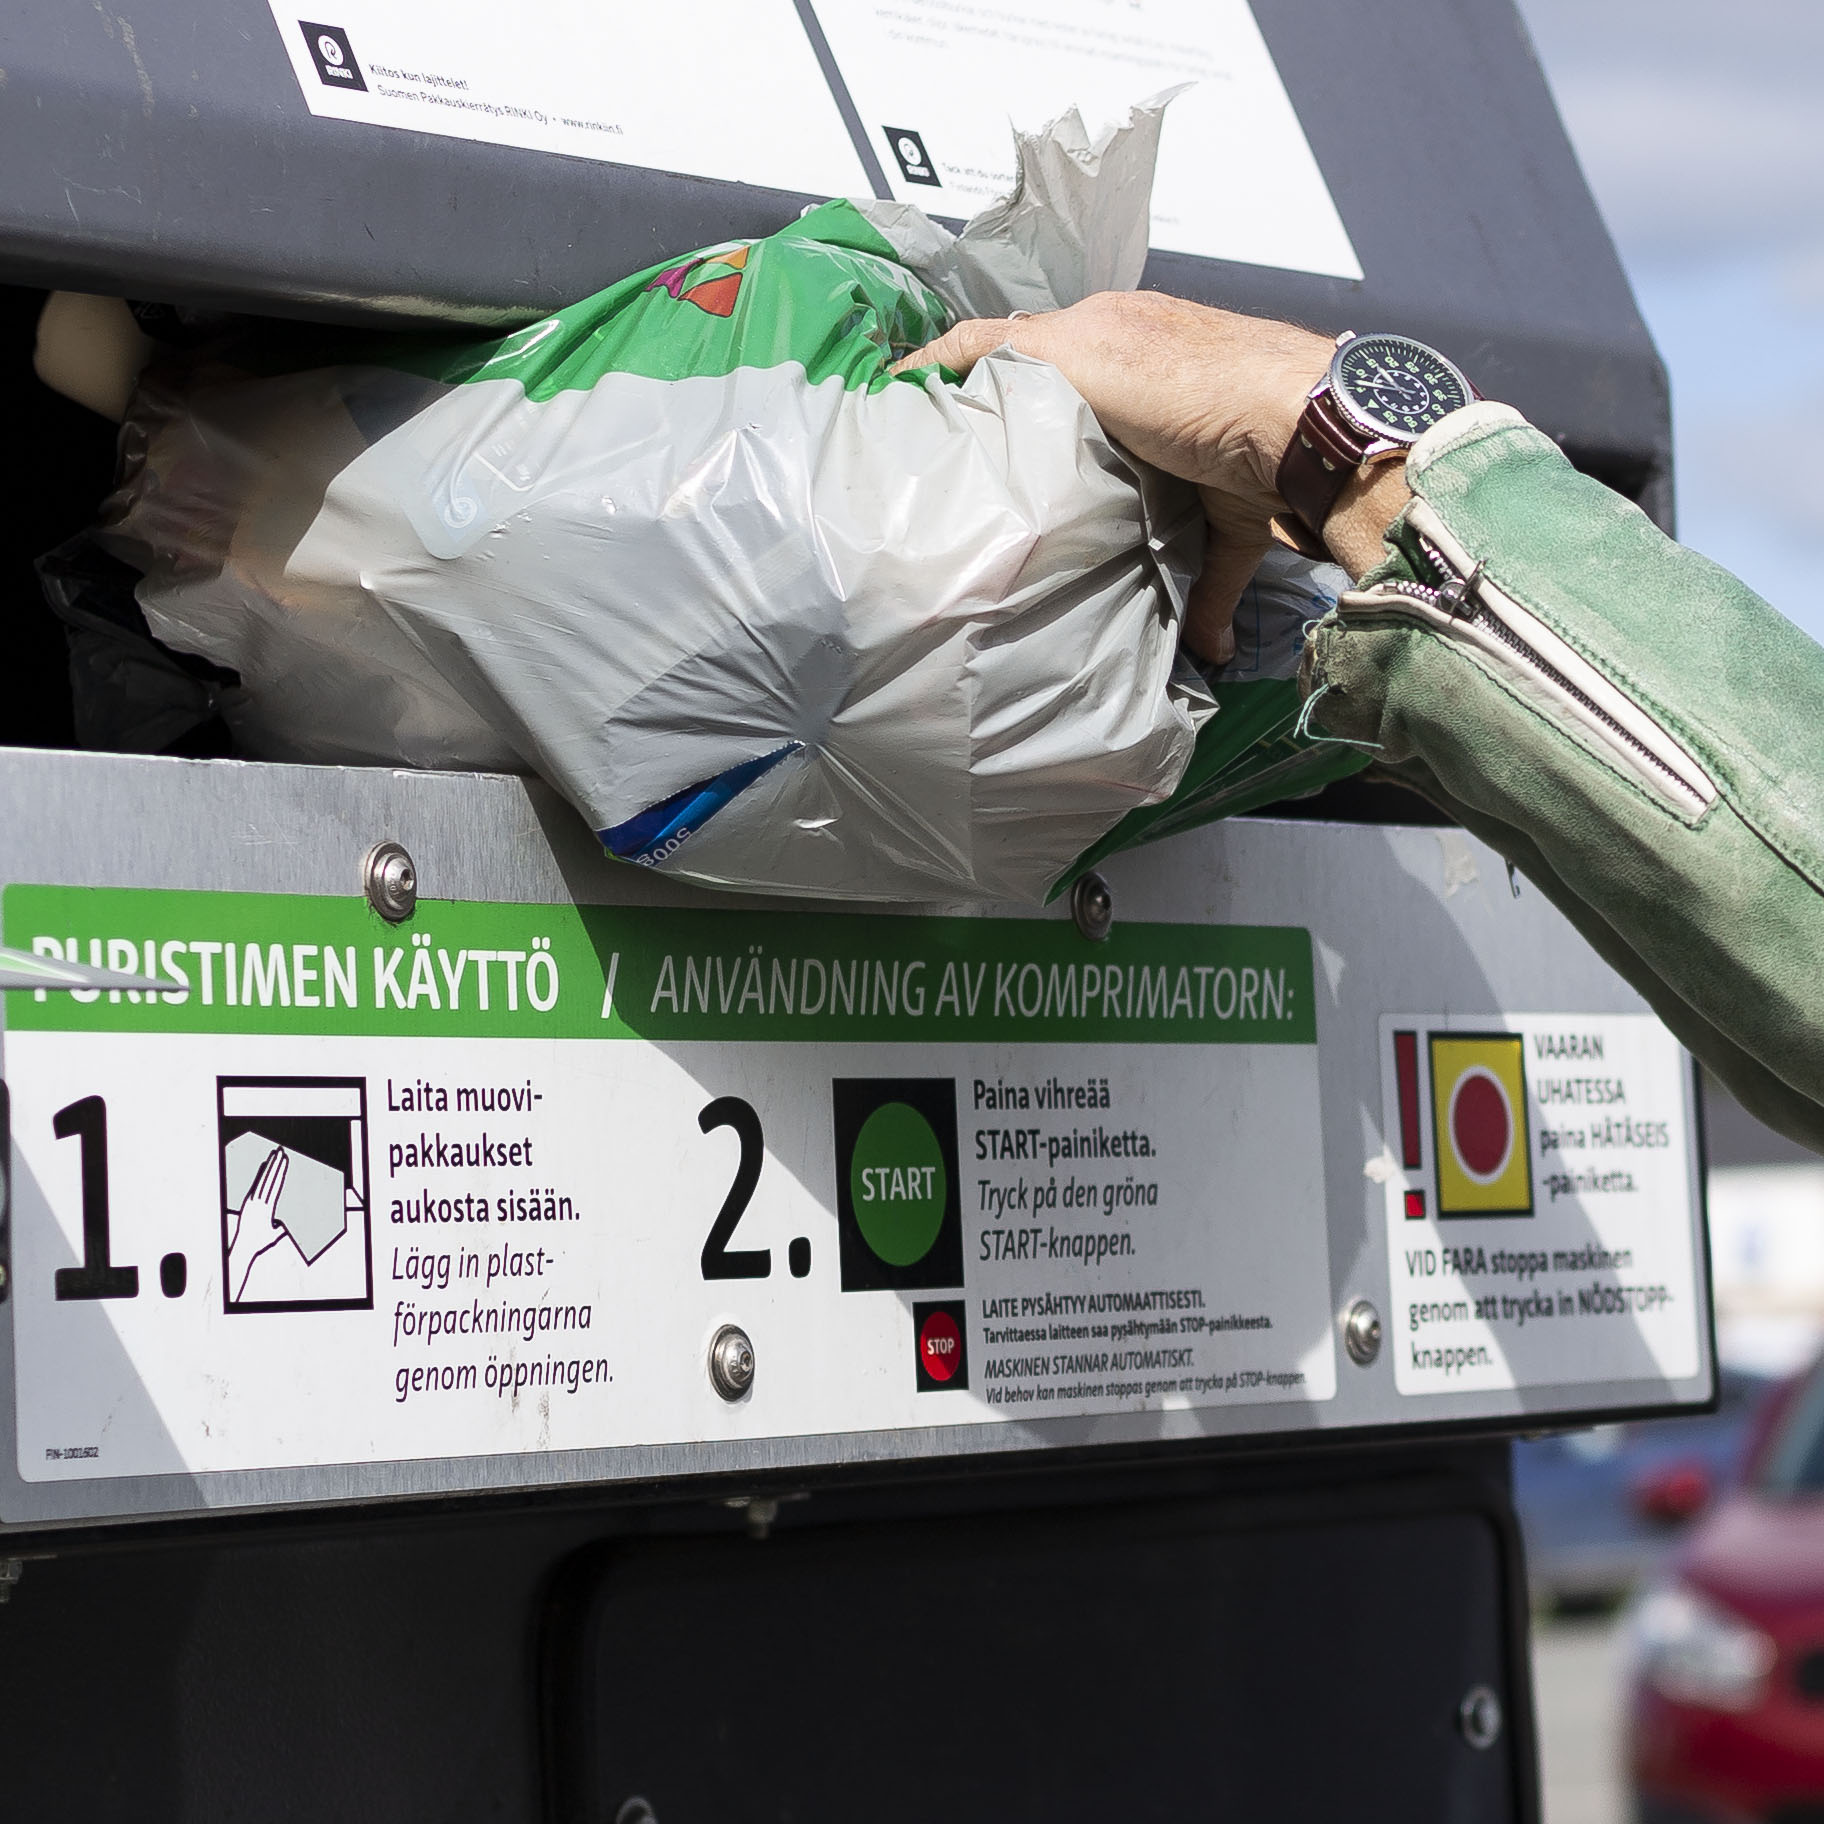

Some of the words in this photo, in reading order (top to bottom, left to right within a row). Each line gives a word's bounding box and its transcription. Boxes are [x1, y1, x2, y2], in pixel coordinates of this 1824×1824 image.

[369, 64, 400, 80] Kiitos
[402, 68, 420, 82] kun
[422, 71, 469, 90] lajittelet!
[377, 84, 419, 102] Suomen
[420, 91, 503, 116] Pakkauskierrätys
[504, 104, 533, 119] RINKI
[534, 109, 549, 125] Oy
[636, 827, 691, 866] 500g
[32, 936, 357, 1008] PURISTIMEN
[374, 933, 560, 1011] KÄYTTÖ
[601, 953, 619, 1018] /
[651, 945, 926, 1017] ANVÄNDNING
[935, 963, 987, 1017] AV
[994, 963, 1294, 1020] KOMPRIMATORN:
[1534, 1034, 1603, 1060] VAARAN
[387, 1078, 448, 1111] Laita
[457, 1080, 543, 1111] muovi-
[973, 1079, 1030, 1110] Paina
[1034, 1077, 1110, 1109] vihreää
[1537, 1079, 1625, 1104] UHATESSA
[389, 1132, 533, 1178] pakkaukset
[975, 1126, 1156, 1168] START-painiketta.
[1540, 1127, 1585, 1157] paina
[1590, 1116, 1668, 1149] HÄTÄSEIS
[51, 1094, 188, 1302] 1.
[696, 1096, 812, 1281] 2.
[861, 1167, 936, 1202] START
[978, 1177, 1028, 1219] Tryck
[1032, 1177, 1057, 1218] på
[1062, 1176, 1097, 1207] den
[1103, 1177, 1158, 1216] gröna
[1542, 1167, 1638, 1201] -painiketta.
[390, 1189, 489, 1223] aukosta
[497, 1188, 580, 1222] sisään.
[392, 1247, 450, 1289] Lägg
[458, 1247, 479, 1278] in
[486, 1242, 554, 1288] plast-
[979, 1227, 1135, 1266] START-knappen.
[1405, 1250, 1436, 1277] VID
[1442, 1248, 1487, 1276] FARA
[1491, 1248, 1548, 1280] stoppa
[1552, 1242, 1632, 1272] maskinen
[393, 1298, 592, 1347] förpackningarna
[982, 1299, 1019, 1318] LAITE
[1022, 1292, 1086, 1317] PYSÄHTYY
[1088, 1290, 1206, 1313] AUTOMAATTISESTI.
[1408, 1299, 1468, 1330] genom
[1473, 1295, 1498, 1320] att
[1500, 1289, 1554, 1326] trycka
[1558, 1288, 1575, 1315] in
[1577, 1281, 1674, 1314] NÖDSTOPP-
[926, 1334, 955, 1357] STOP
[983, 1325, 1046, 1344] Tarvittaessa
[1049, 1323, 1089, 1341] laitteen
[1091, 1327, 1108, 1339] saa
[1111, 1319, 1177, 1342] pysähtymään
[1179, 1314, 1273, 1335] STOP-painikkeesta.
[984, 1355, 1049, 1378] MASKINEN
[1052, 1353, 1108, 1374] STANNAR
[1110, 1348, 1194, 1372] AUTOMATISKT.
[1411, 1342, 1492, 1375] knappen.
[395, 1361, 477, 1402] genom
[484, 1354, 613, 1398] öppningen.
[986, 1387, 1002, 1404] Vid
[1005, 1385, 1034, 1403] behov
[1036, 1384, 1054, 1400] kan
[1057, 1381, 1104, 1398] maskinen
[1105, 1381, 1143, 1399] stoppas
[1145, 1381, 1177, 1398] genom
[1179, 1379, 1193, 1391] att
[1195, 1376, 1223, 1394] trycka
[1225, 1375, 1238, 1391] på
[1239, 1372, 1305, 1388] STOP-knappen.
